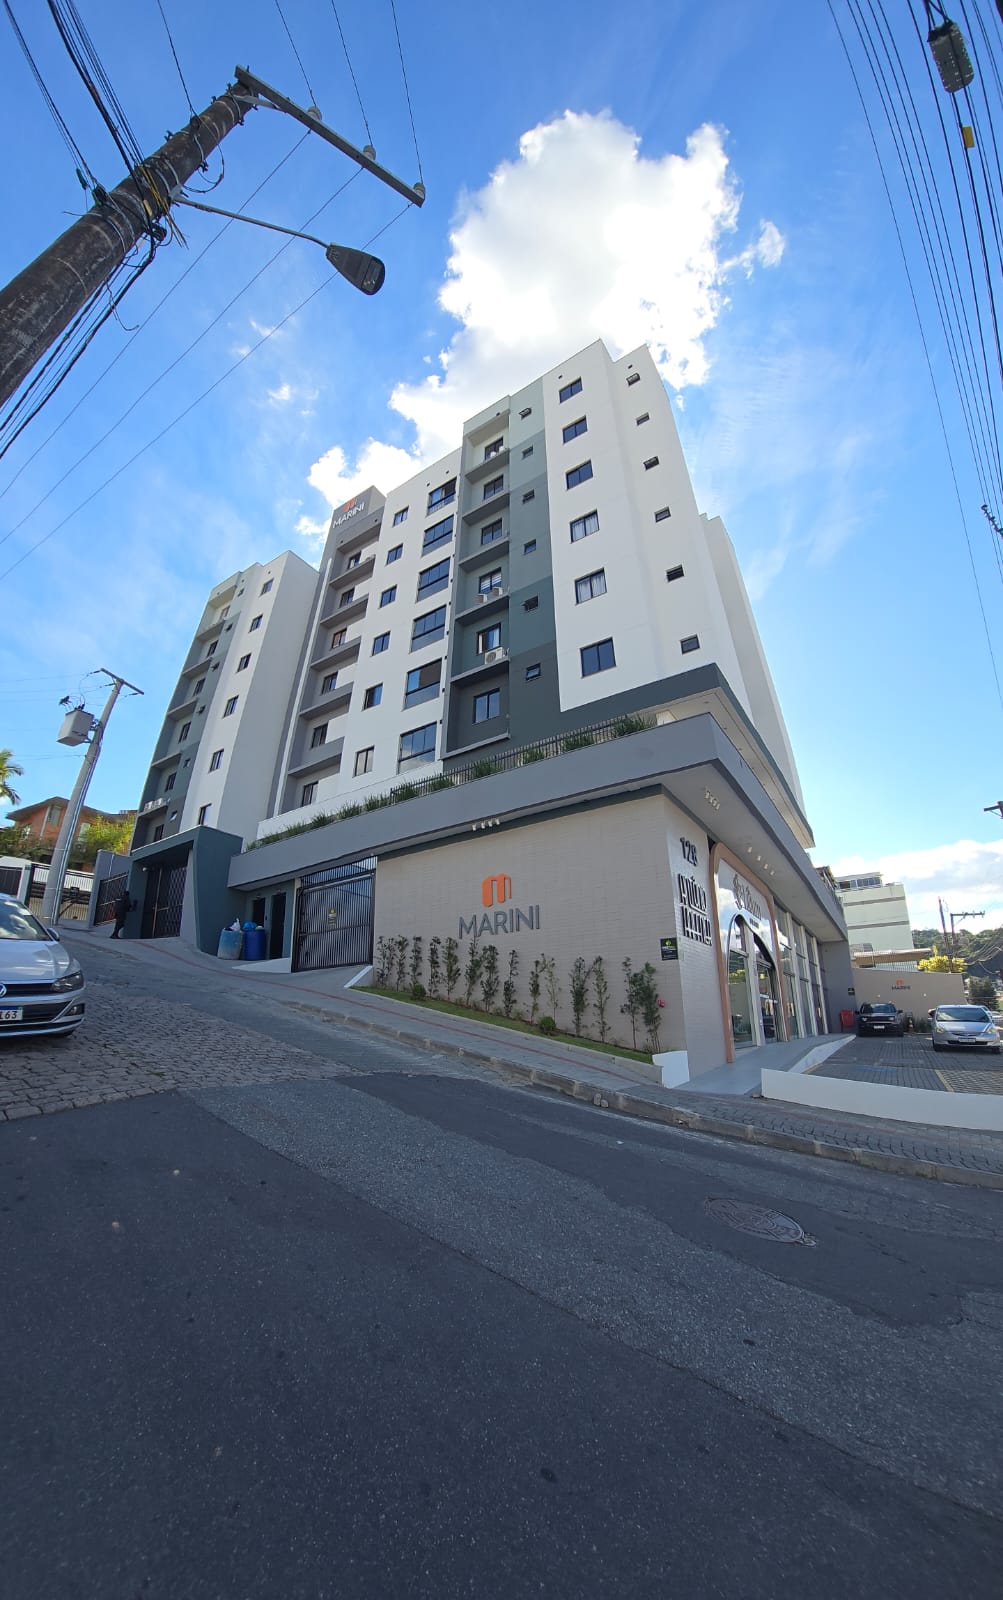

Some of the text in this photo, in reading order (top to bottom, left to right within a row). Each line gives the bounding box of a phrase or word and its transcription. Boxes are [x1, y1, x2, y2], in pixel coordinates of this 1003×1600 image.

[333, 502, 365, 528] MARINI
[680, 837, 698, 866] 128
[459, 905, 540, 939] MARINI
